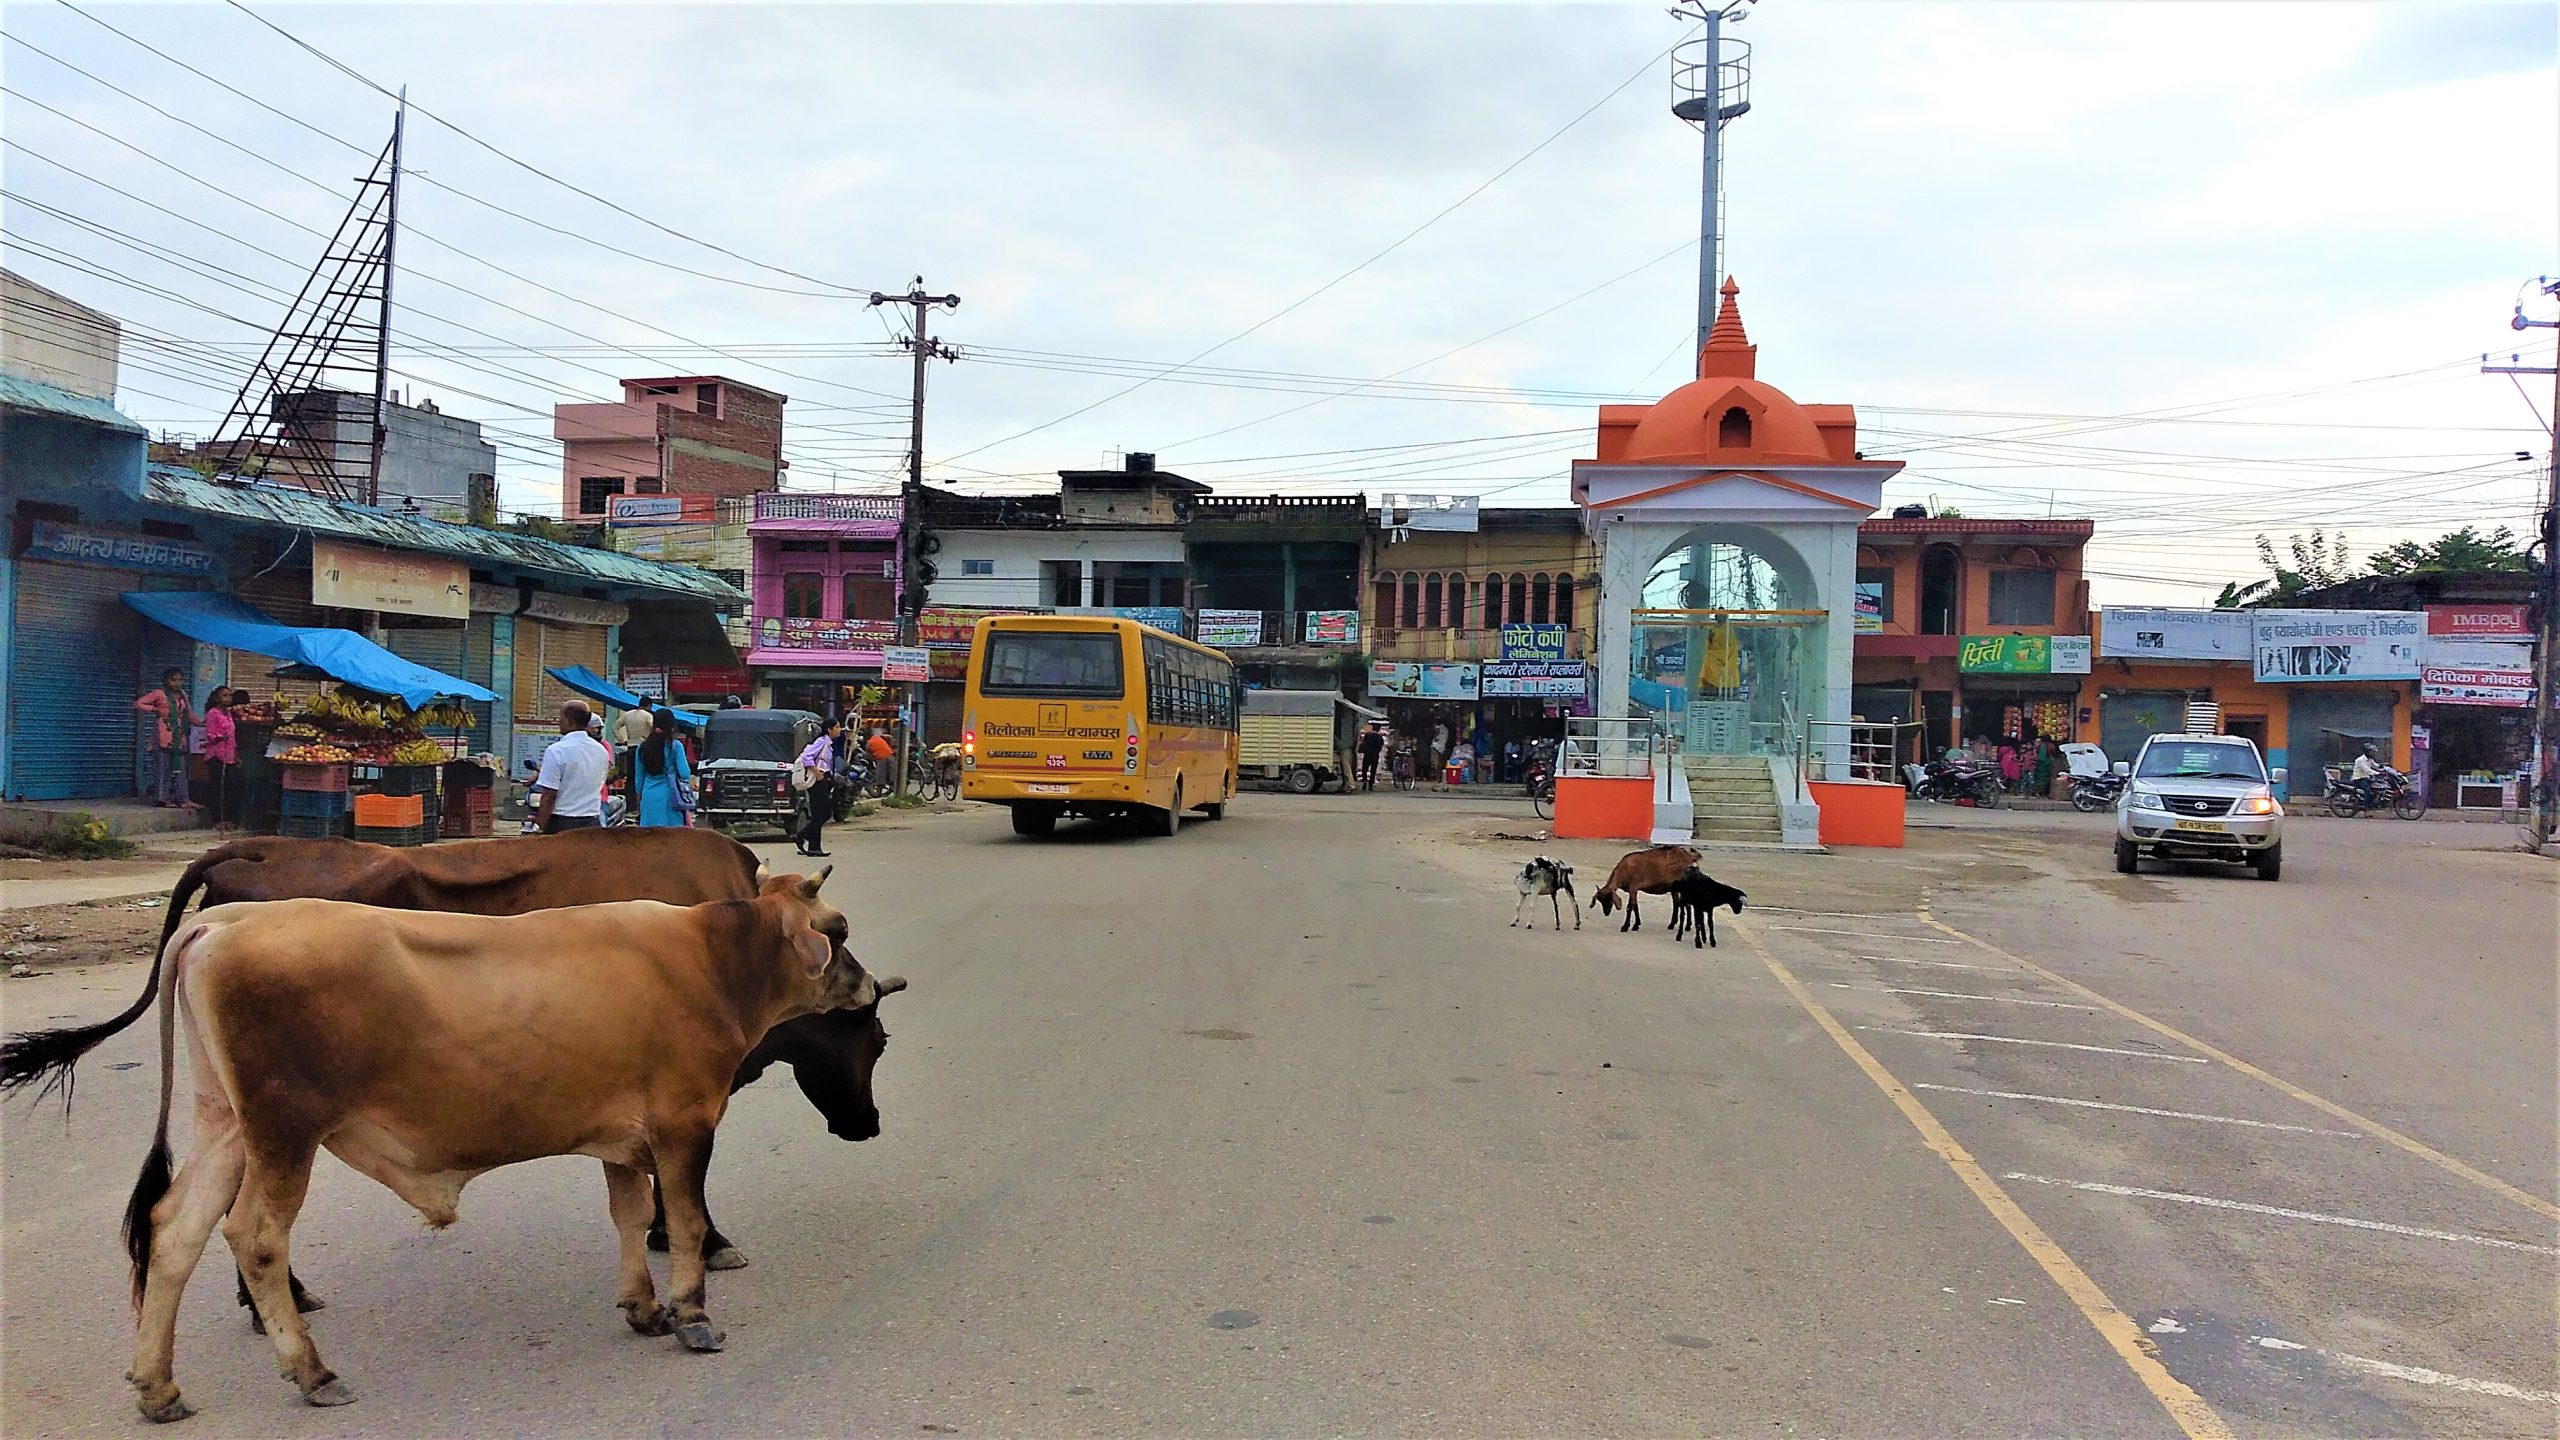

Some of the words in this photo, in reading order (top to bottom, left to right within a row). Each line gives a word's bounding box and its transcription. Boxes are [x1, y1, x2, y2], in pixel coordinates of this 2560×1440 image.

[1503, 624, 1535, 647] फोटो
[1537, 625, 1564, 648] कपी
[984, 722, 1035, 737] तिलोतमा
[1067, 726, 1121, 739] क्याम्पस
[1084, 751, 1112, 760] TATA
